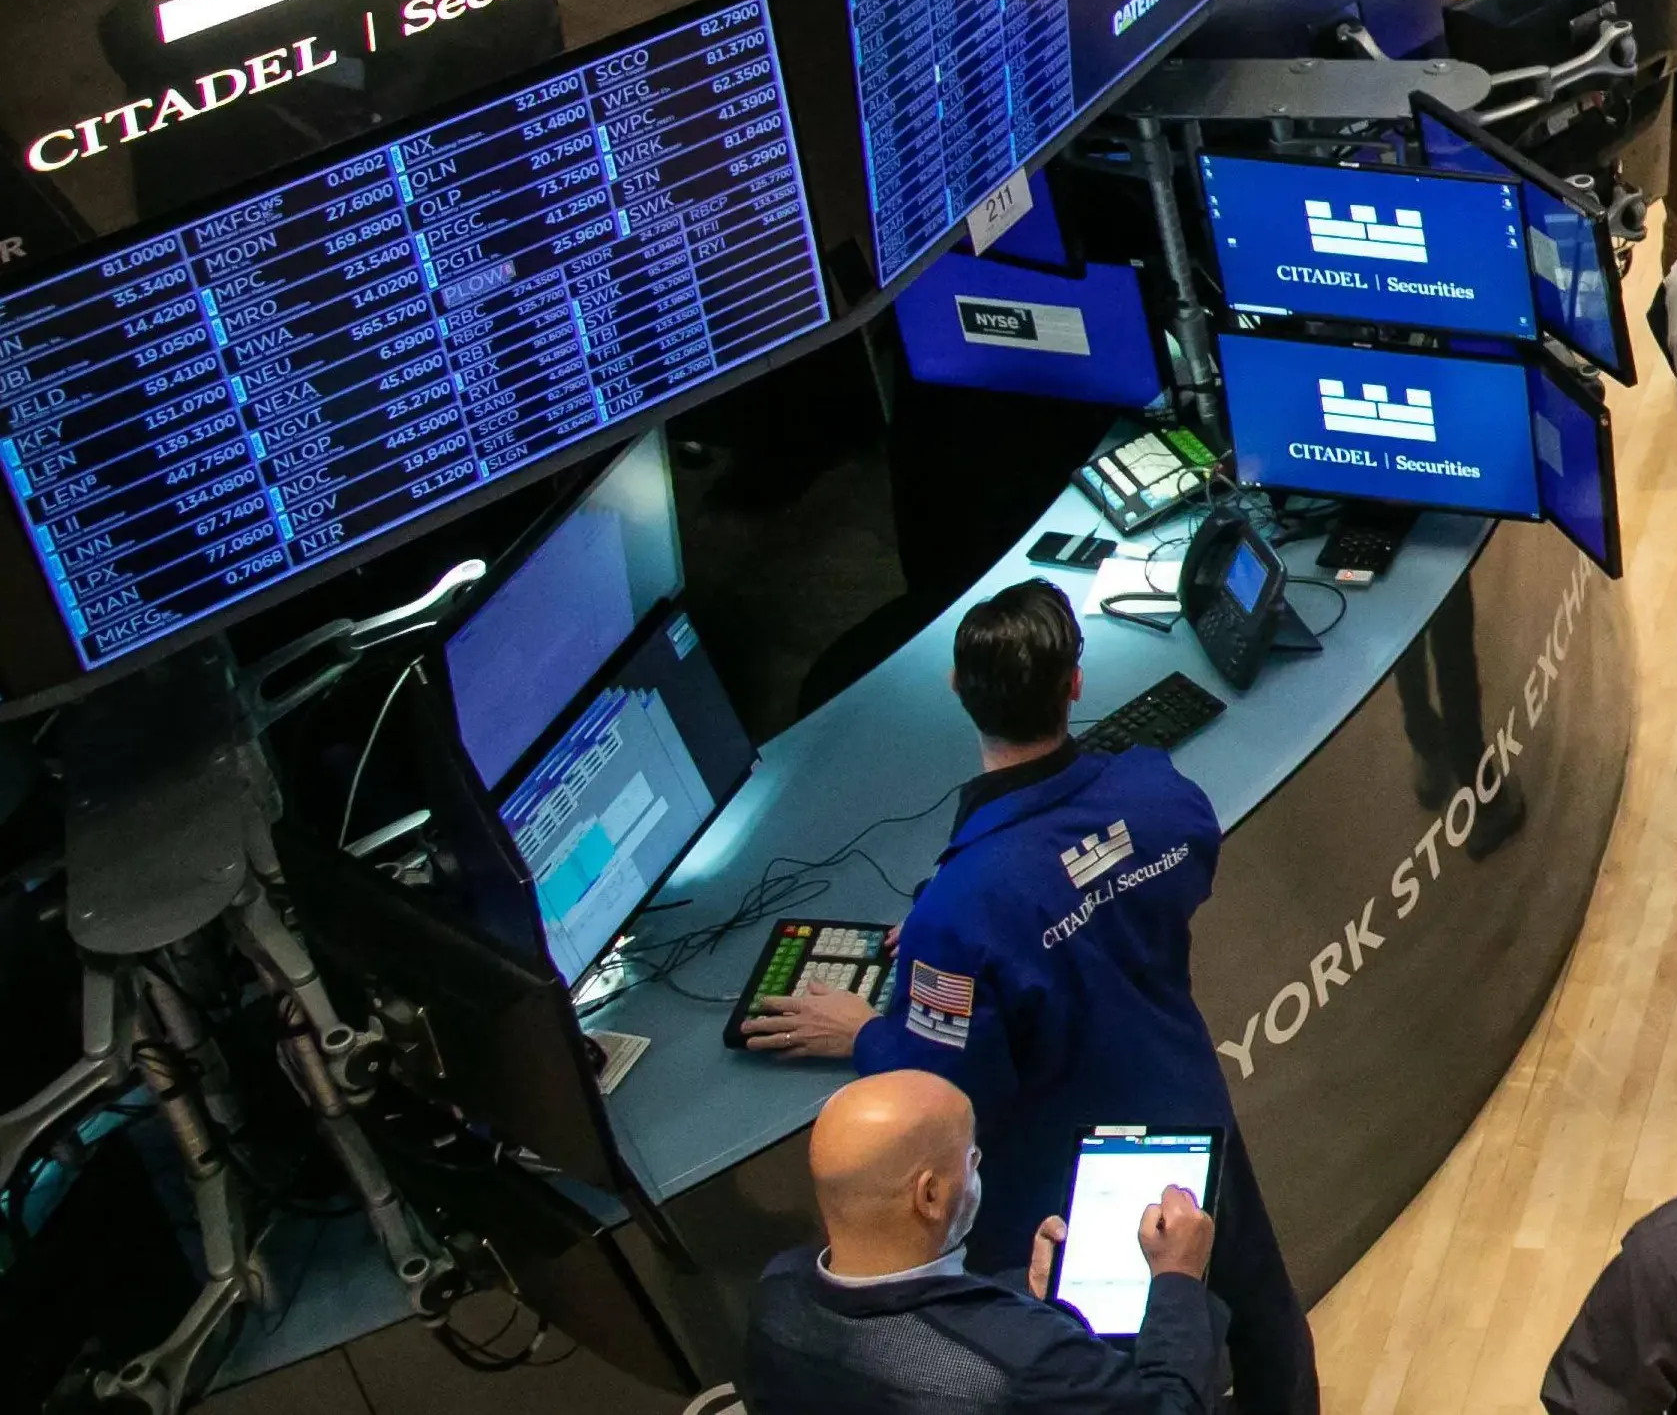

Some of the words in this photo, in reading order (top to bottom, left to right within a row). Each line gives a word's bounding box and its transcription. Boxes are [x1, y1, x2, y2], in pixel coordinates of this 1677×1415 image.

[595, 50, 649, 84] SCCO
[700, 3, 760, 38] 82.7900
[26, 36, 338, 175] CITADEL
[404, 134, 435, 158] NX
[516, 76, 579, 112] 32.1600
[609, 108, 658, 139] WPC
[711, 60, 771, 95] 62.3500
[428, 212, 486, 247] PFGC
[537, 162, 601, 199] 73.7500
[628, 192, 675, 225] SWK
[729, 142, 788, 178] 95.2900
[984, 186, 1013, 225] 211
[205, 232, 279, 273] MODN
[326, 185, 394, 222] 27.6000
[227, 300, 277, 332] MRO
[343, 242, 410, 281] 23.5400
[1276, 265, 1368, 290] CITADEL
[1387, 276, 1475, 300] Securities
[245, 358, 292, 388] NEU
[350, 300, 427, 342] 565.5700
[30, 451, 77, 482] LEN
[145, 386, 227, 430] 151.0700
[1288, 442, 1378, 467] CITADEL
[1395, 454, 1480, 479] Securities
[51, 517, 80, 541] LII
[166, 442, 246, 486] 447.7500
[301, 524, 345, 556] NTR
[411, 461, 475, 500] 51.1200
[85, 587, 140, 621] MAN
[206, 523, 274, 563] 77.0600
[1042, 887, 1118, 950] CITADEL
[1116, 842, 1191, 893] Securities
[1216, 895, 1386, 1081] YORK
[1391, 705, 1525, 921] STOCK
